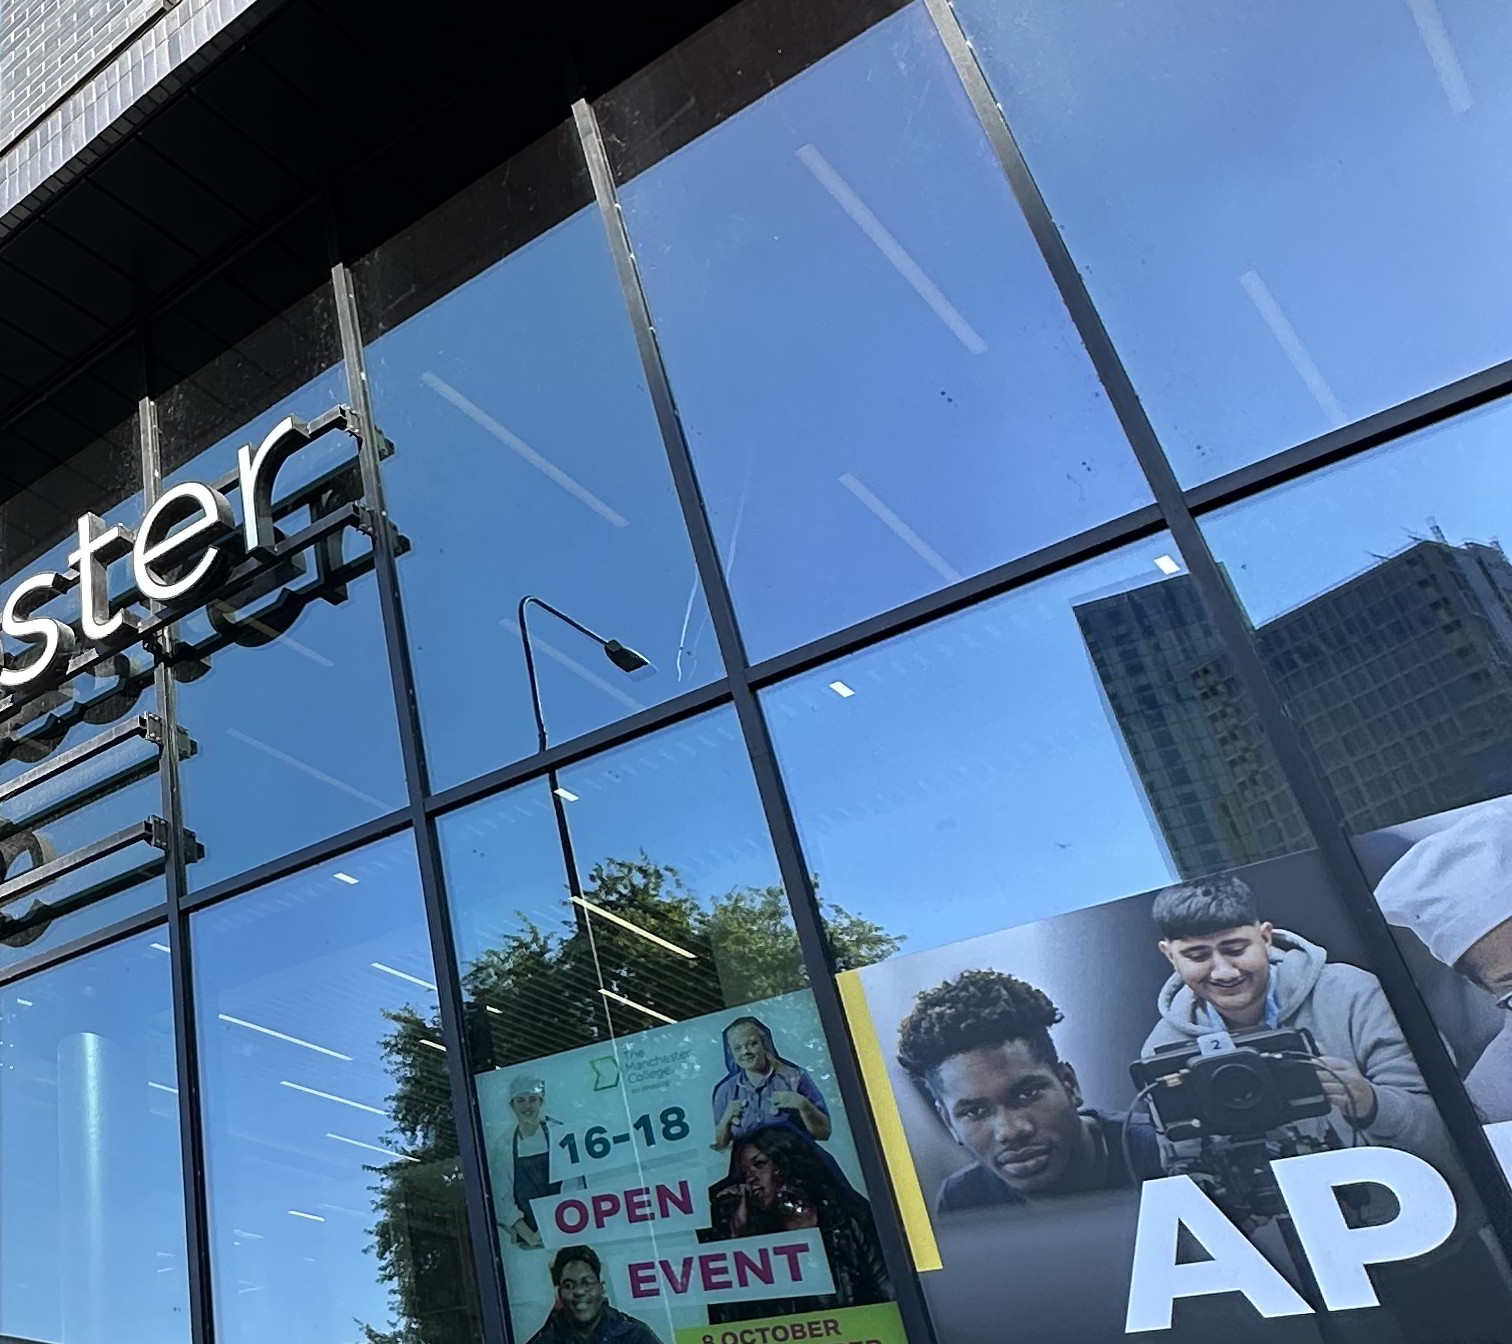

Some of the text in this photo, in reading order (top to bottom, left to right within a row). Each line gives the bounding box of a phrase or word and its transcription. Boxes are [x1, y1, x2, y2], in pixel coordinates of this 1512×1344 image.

[1210, 1039, 1223, 1050] 2
[559, 1106, 690, 1164] 16-18
[555, 1180, 694, 1234] OPEN
[628, 1243, 809, 1298] EVENT
